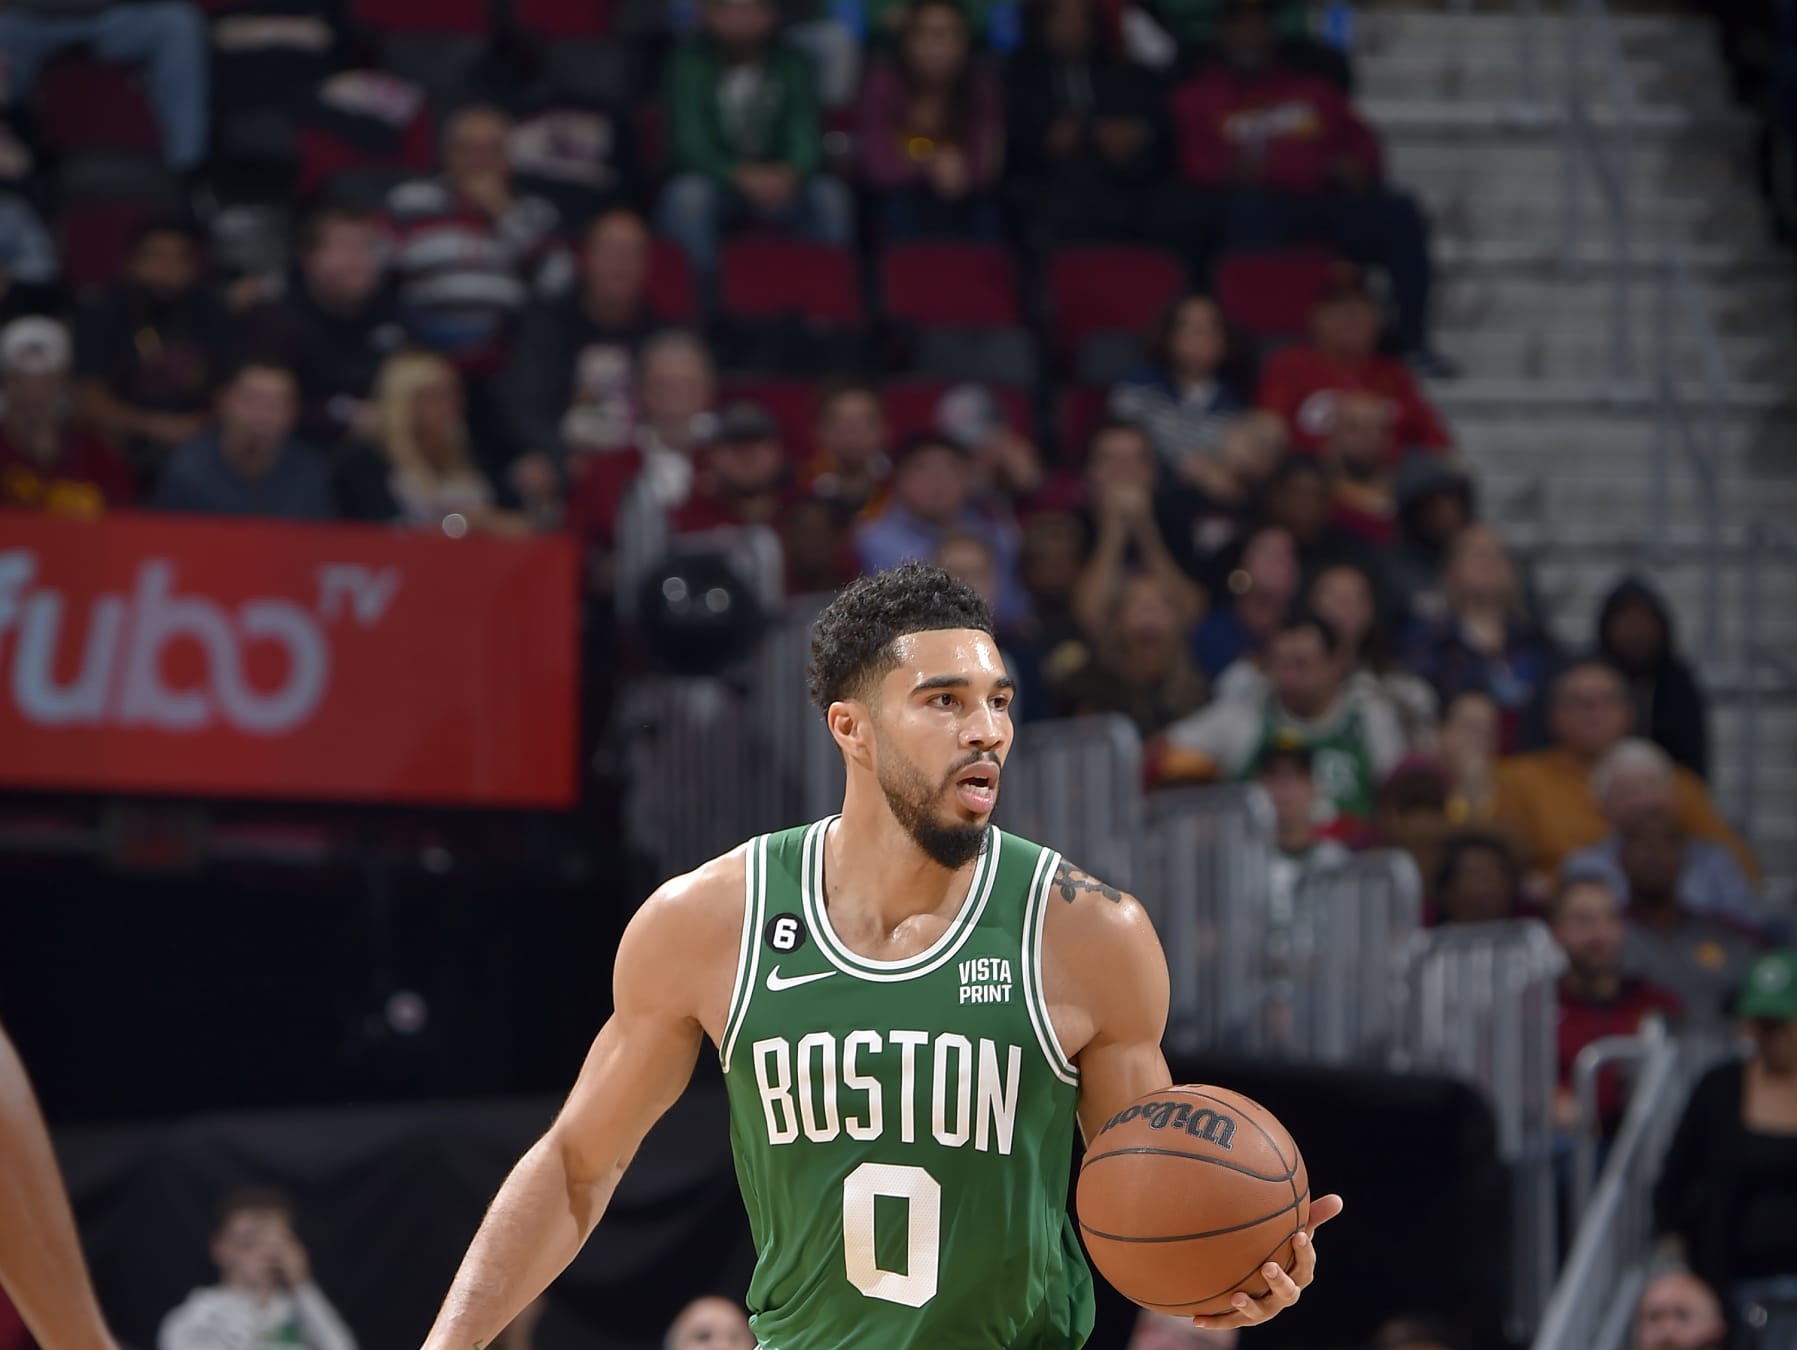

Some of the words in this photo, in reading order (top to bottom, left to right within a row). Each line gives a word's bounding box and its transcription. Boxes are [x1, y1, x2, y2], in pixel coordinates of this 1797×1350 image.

[316, 562, 398, 624] TV
[773, 917, 798, 950] 6
[958, 957, 1013, 985] VISTA
[959, 983, 1013, 1005] PRINT
[752, 1030, 1022, 1156] BOSTON
[1099, 1101, 1238, 1151] Wilson
[842, 1162, 942, 1309] 0
